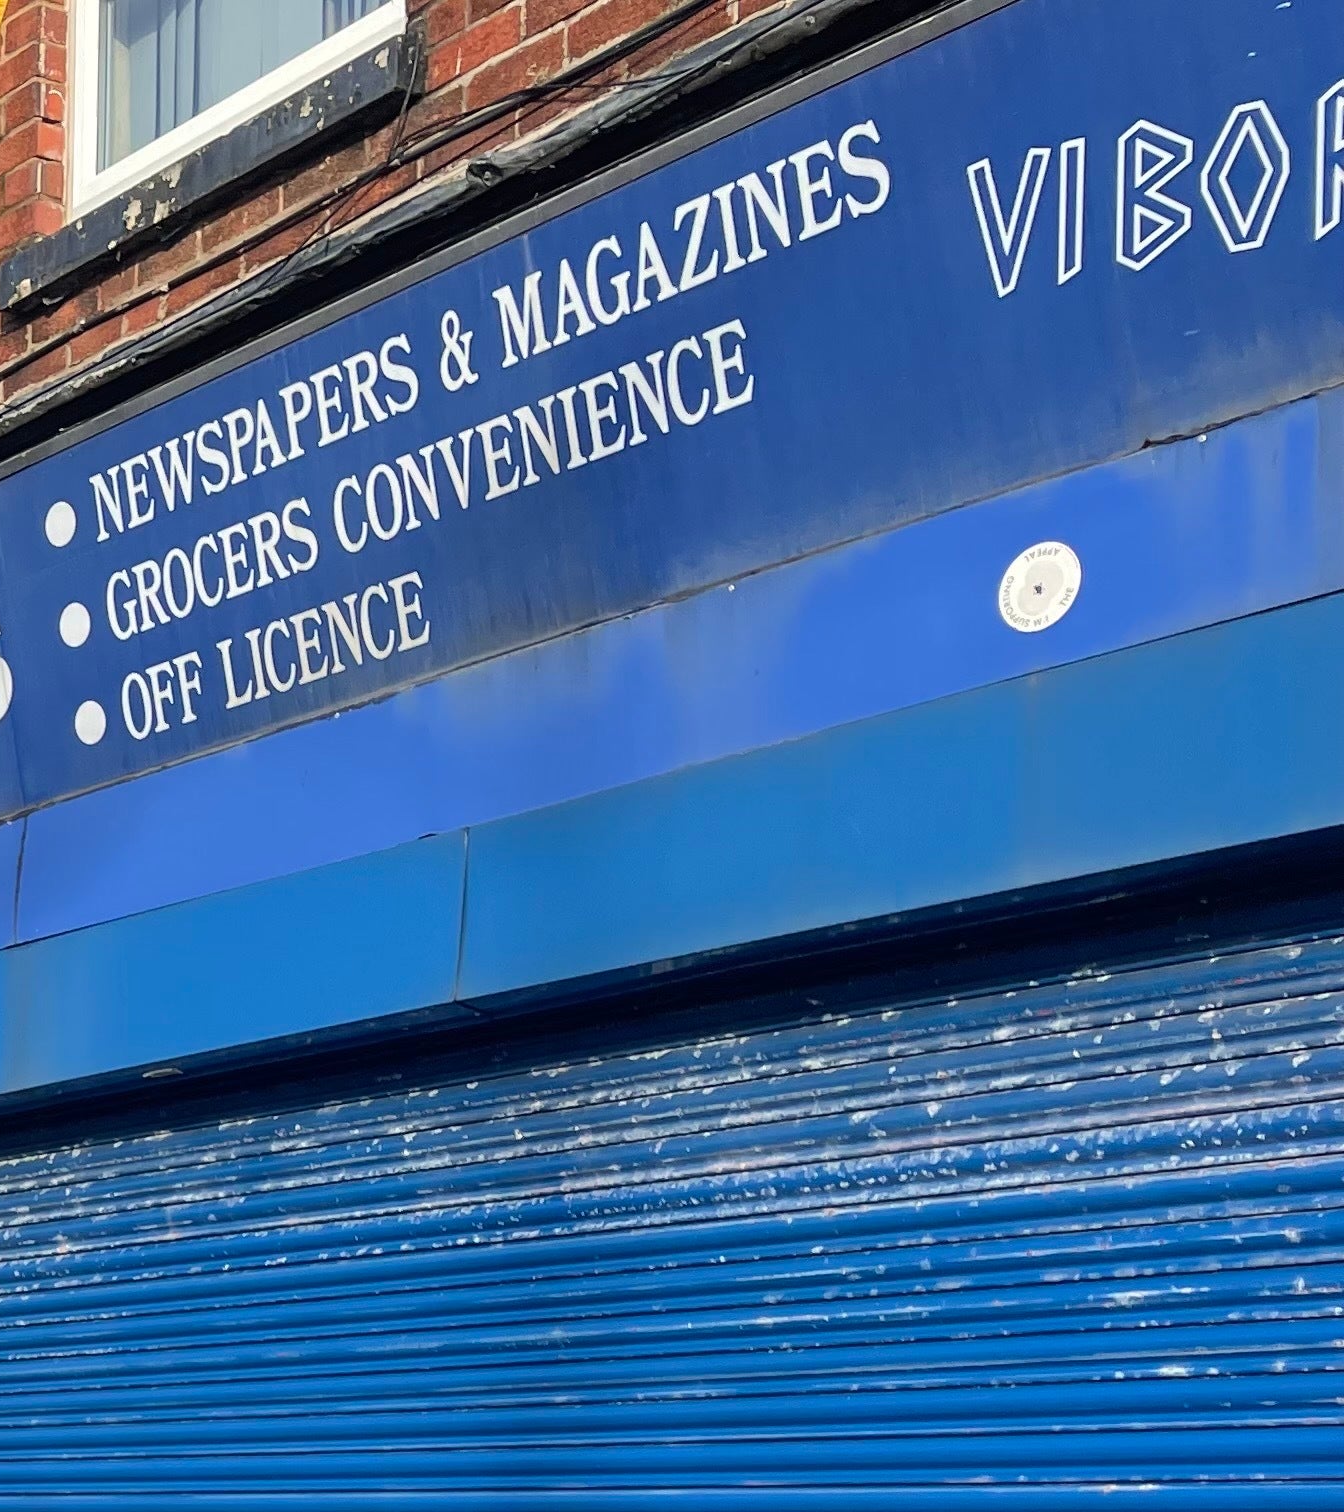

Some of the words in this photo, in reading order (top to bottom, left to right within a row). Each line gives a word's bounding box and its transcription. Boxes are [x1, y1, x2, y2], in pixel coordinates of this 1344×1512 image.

[89, 332, 420, 544] NEWSPAPERS
[440, 309, 480, 392] &
[492, 120, 893, 369] MAGAZINES
[106, 497, 320, 642] GROCERS
[332, 318, 756, 555] CONVENIENCE
[120, 655, 204, 741] OFF
[217, 570, 431, 711] LICENCE
